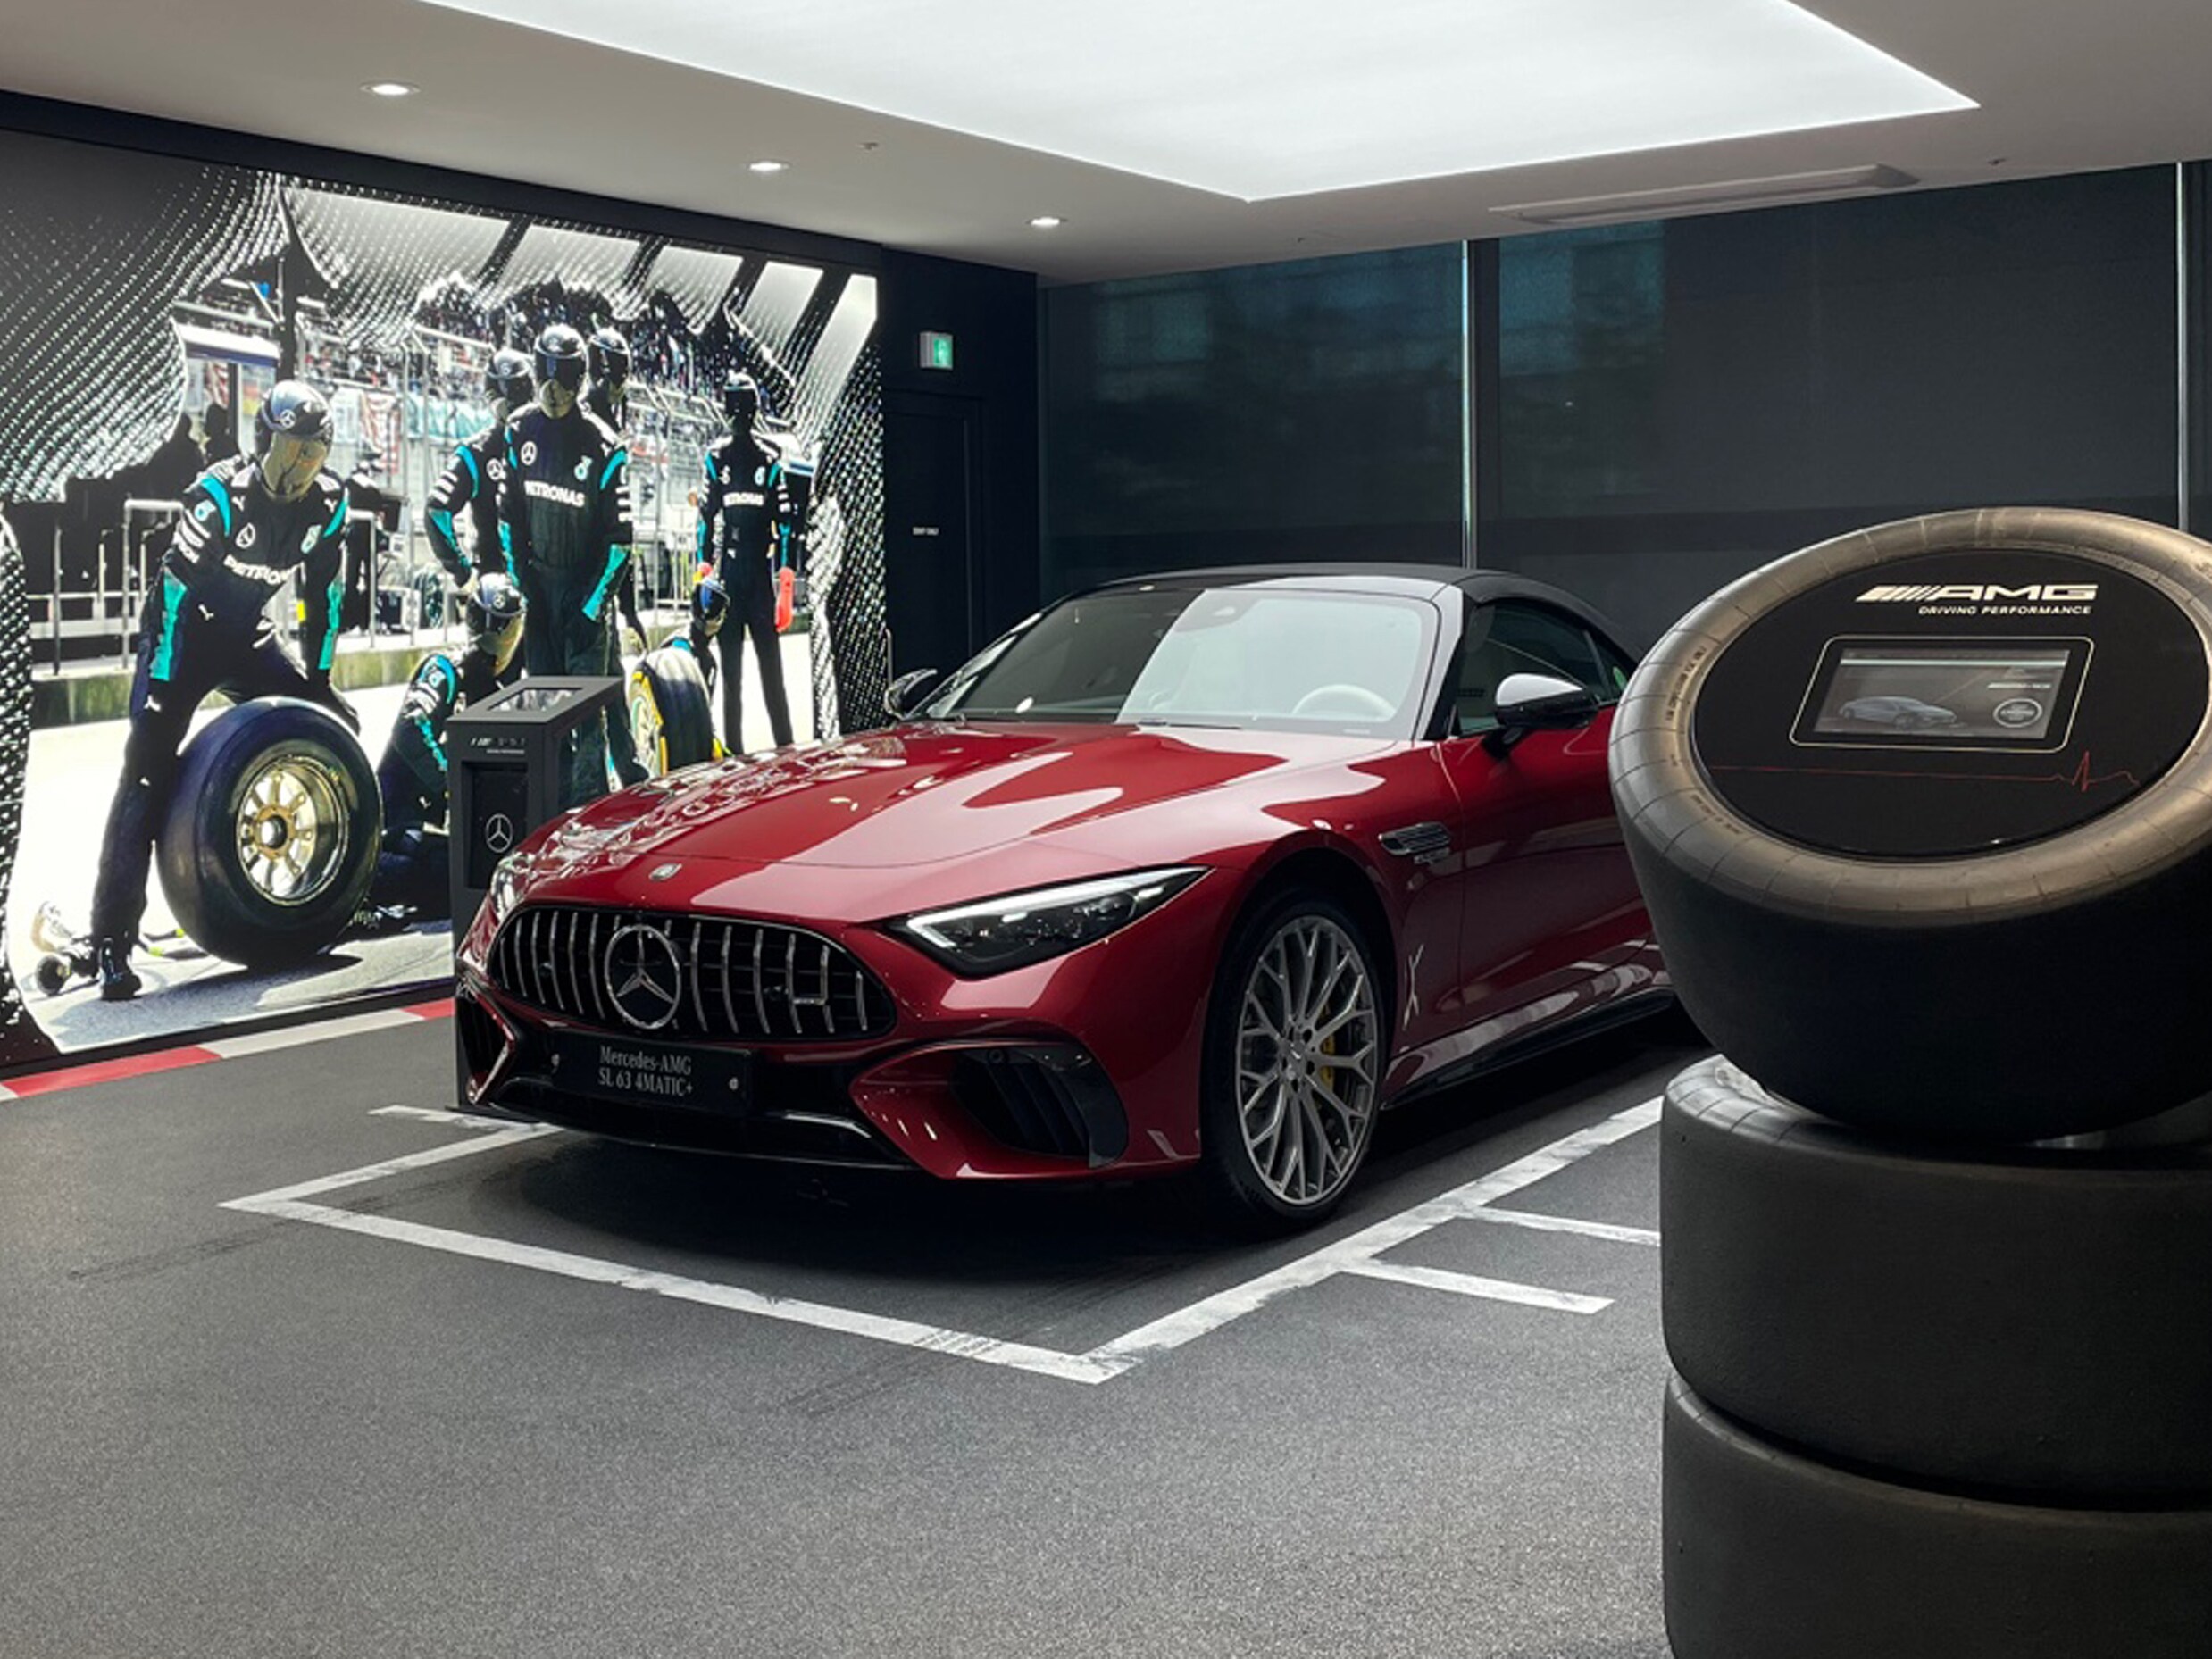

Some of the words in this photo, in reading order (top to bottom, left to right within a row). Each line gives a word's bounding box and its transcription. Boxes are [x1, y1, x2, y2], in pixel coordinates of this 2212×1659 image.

[524, 480, 585, 507] PETRONAS
[1918, 605, 1976, 614] DRIVING
[1982, 605, 2091, 615] PERFORMANCE
[599, 1045, 692, 1075] Mercedes-AMG
[598, 1067, 614, 1087] SL
[615, 1070, 631, 1089] 63
[635, 1072, 693, 1096] 4MATIC+
